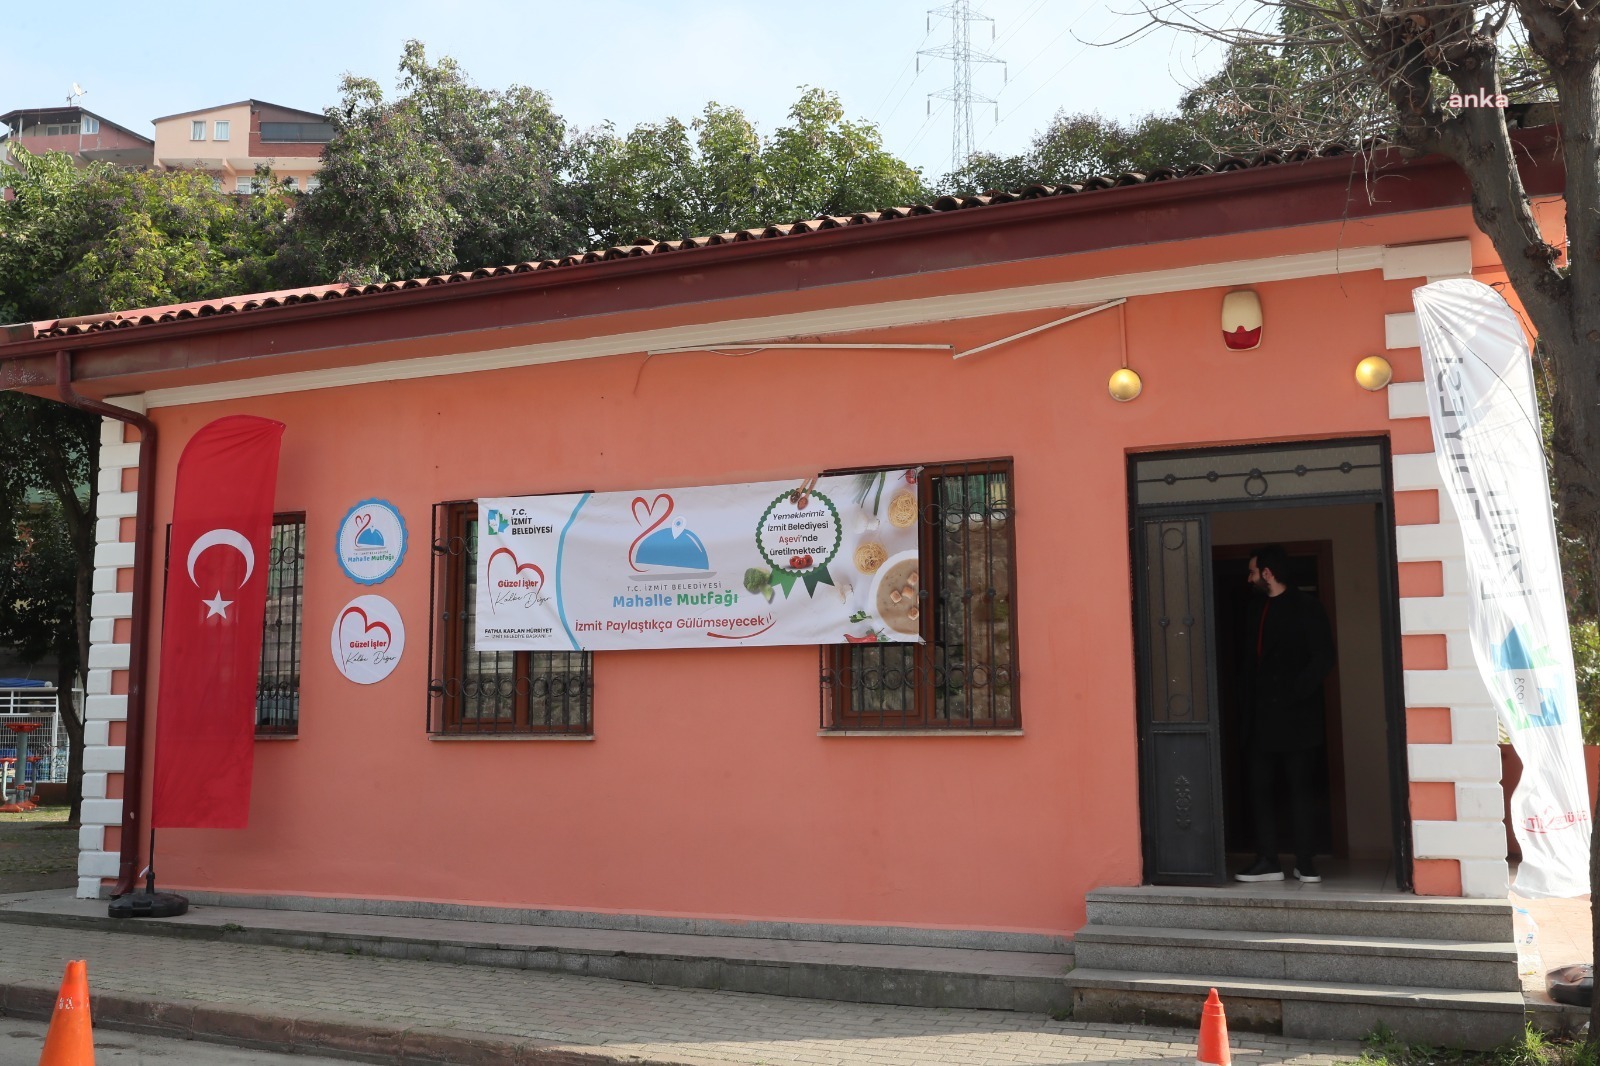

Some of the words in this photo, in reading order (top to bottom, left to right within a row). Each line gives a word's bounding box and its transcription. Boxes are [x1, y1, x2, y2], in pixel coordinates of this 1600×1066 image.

[511, 508, 527, 516] T.C.
[773, 509, 825, 521] Yemeklerimiz
[511, 516, 533, 526] İZMİT
[767, 522, 786, 532] İzmit
[787, 520, 829, 531] Belediyesi
[511, 524, 553, 535] BELEDİYESİ
[778, 534, 818, 545] Aşevi'nde
[769, 545, 829, 556] üretilmektedir.
[497, 579, 521, 588] Güzel
[522, 577, 539, 589] İşler
[644, 583, 668, 592] İZMİT
[671, 581, 722, 591] BELEDİYESİ
[612, 593, 673, 608] Mahalle
[676, 589, 738, 607] Mutfağı
[575, 619, 602, 632] İzmit
[606, 619, 673, 633] Paylaştıkça
[676, 615, 765, 630] Gülümseyecek
[349, 640, 370, 648] Güzel
[370, 639, 387, 649] İşler
